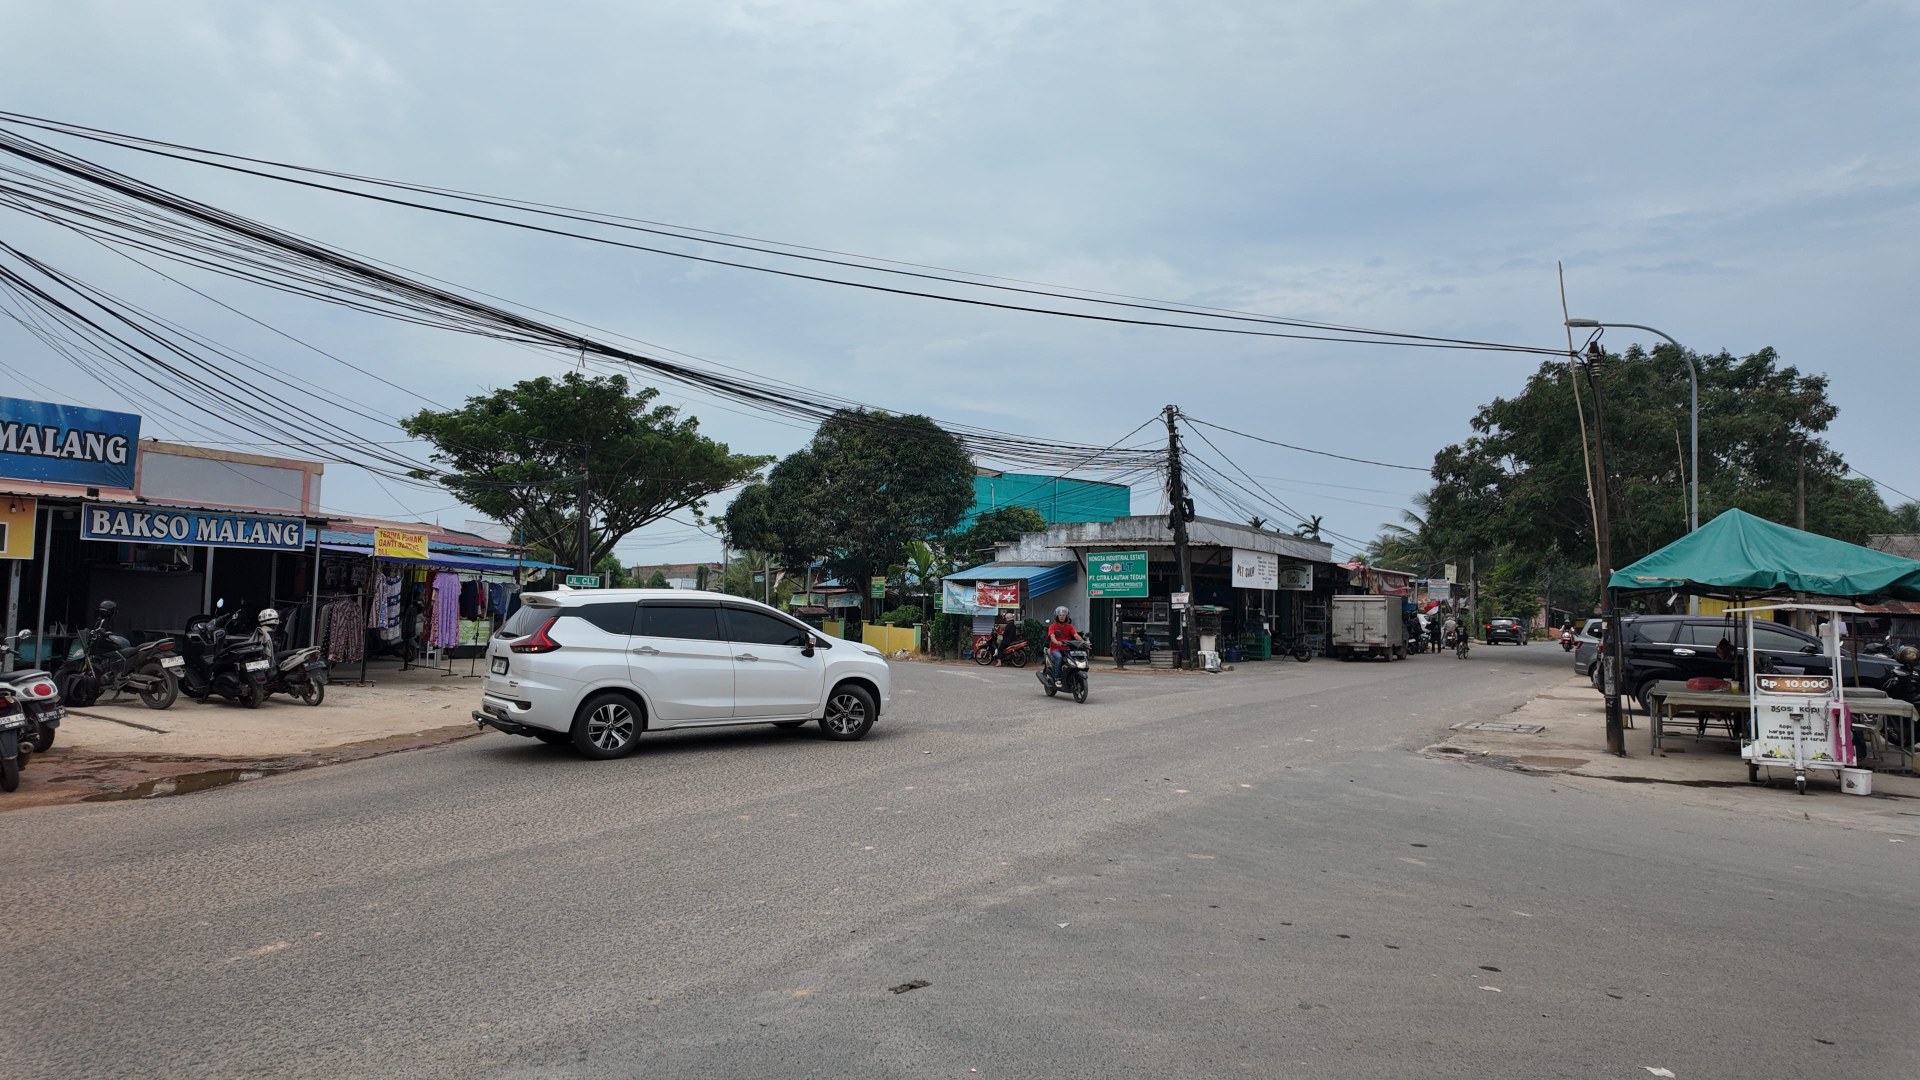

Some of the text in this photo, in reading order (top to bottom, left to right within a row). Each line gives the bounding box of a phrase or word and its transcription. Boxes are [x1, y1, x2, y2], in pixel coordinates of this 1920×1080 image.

[0, 421, 127, 465] MALANG
[91, 508, 300, 547] BAKSO MALANG
[582, 577, 596, 585] CLT
[1761, 678, 1829, 689] Rp. 10.000
